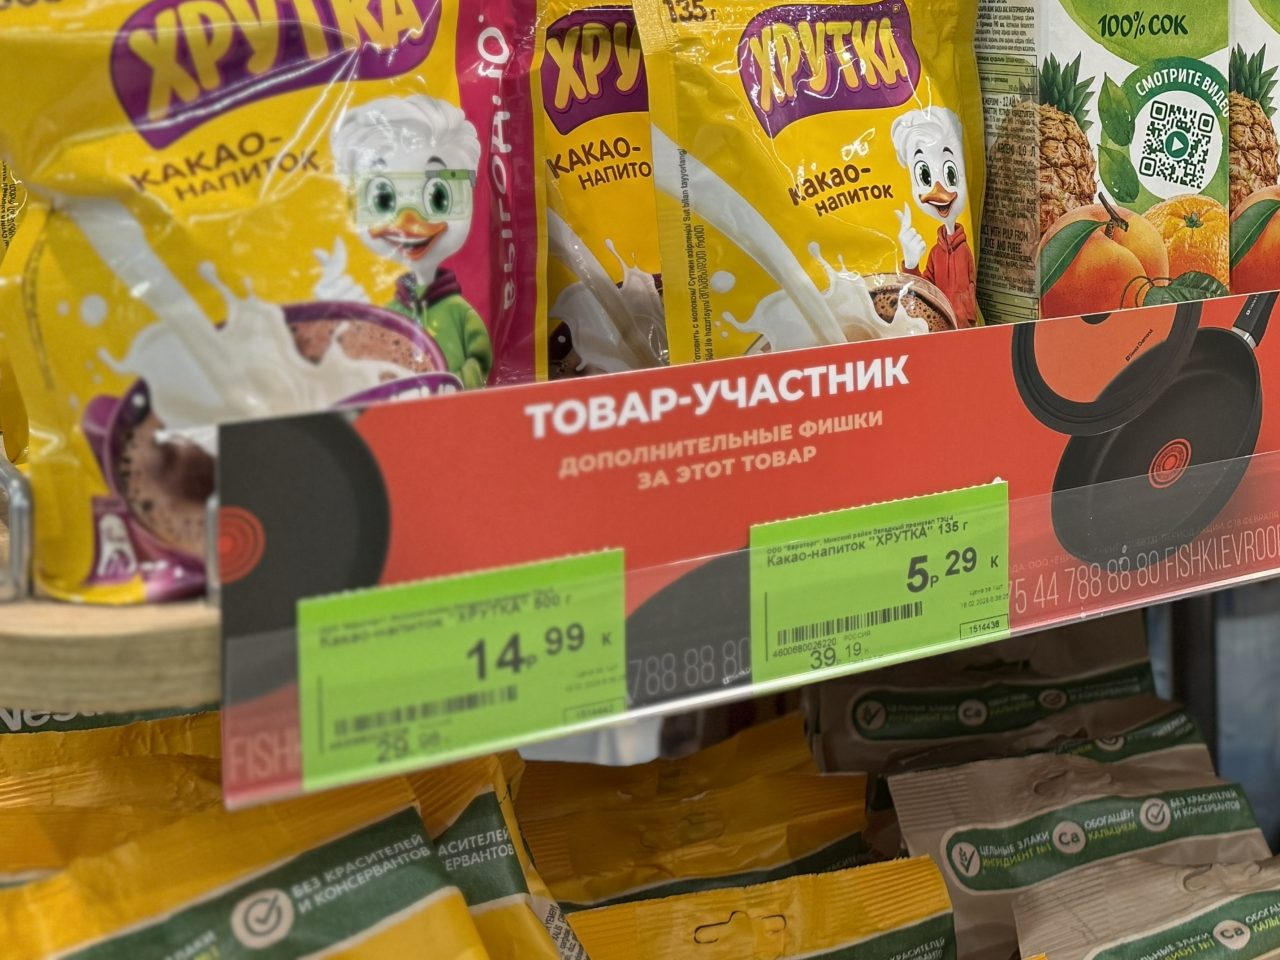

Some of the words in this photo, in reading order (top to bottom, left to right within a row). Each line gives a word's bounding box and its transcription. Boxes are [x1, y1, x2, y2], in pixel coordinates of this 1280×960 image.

[1097, 10, 1146, 39] 100%
[1148, 14, 1189, 35] СОК
[748, 18, 908, 113] ХРУТКА
[1135, 67, 1202, 96] СМОТРИТЕ
[1202, 79, 1229, 118] ВИДЕО
[130, 131, 283, 194] КАКАО-
[173, 150, 323, 203] НАПИТОК
[547, 136, 642, 179] КАКАО-
[525, 354, 910, 439] ТОВАР-УЧАСТНИК
[558, 424, 793, 480] ДОПОЛНИТЕЛЬНЫЕ
[798, 410, 883, 438] ФИШКИ
[637, 472, 670, 490] ЗА
[677, 458, 735, 484] ЭТОТ
[741, 446, 817, 473] ТОВАР
[766, 540, 865, 568] Какао-напиток
[869, 526, 933, 548] "ХРУТКА"
[937, 521, 959, 535] 135
[906, 555, 928, 593] 5
[944, 546, 977, 576] 29
[1033, 572, 1059, 608] 44
[1064, 563, 1101, 604] 788
[1107, 557, 1131, 593] 88
[1137, 550, 1159, 586] 80
[465, 633, 525, 683] 14
[544, 622, 585, 657] 99
[810, 648, 836, 670] 39
[845, 642, 862, 658] 19
[1058, 830, 1080, 845] Ca
[1220, 926, 1246, 939] Ca
